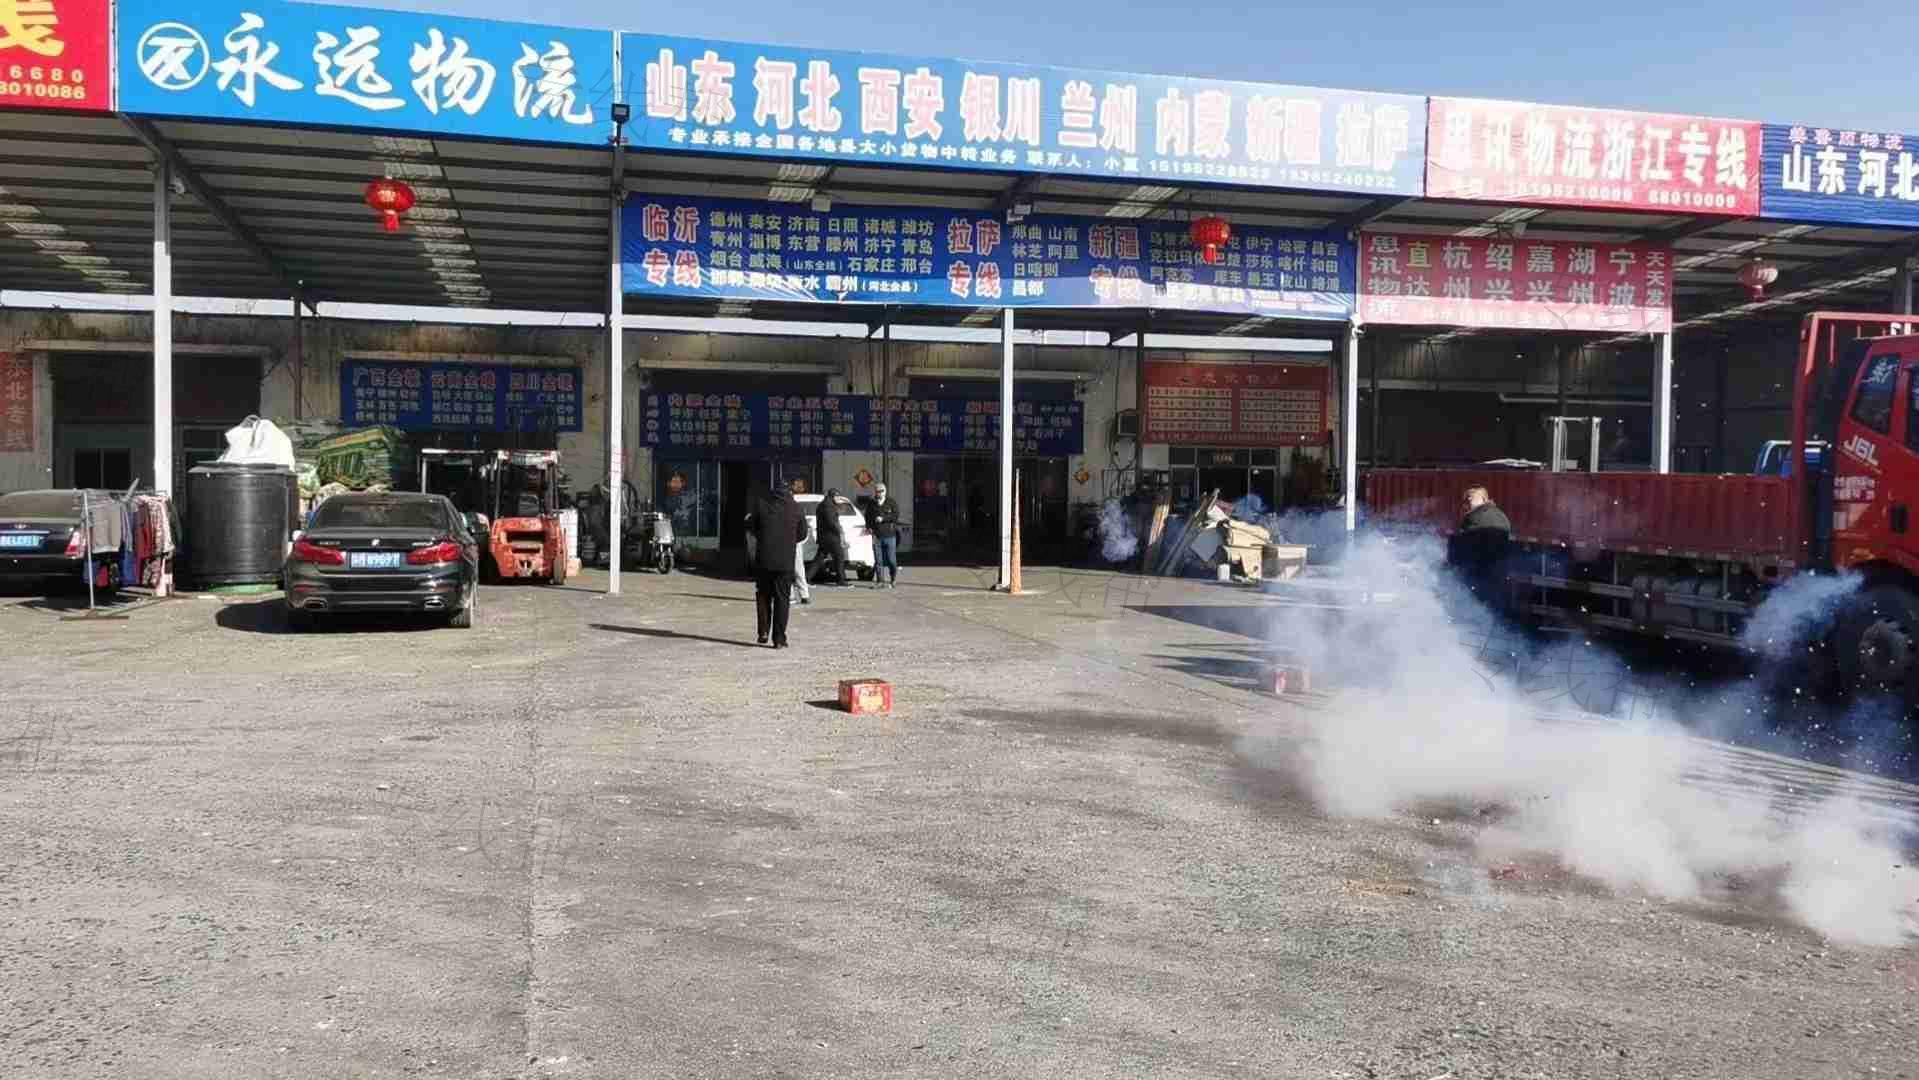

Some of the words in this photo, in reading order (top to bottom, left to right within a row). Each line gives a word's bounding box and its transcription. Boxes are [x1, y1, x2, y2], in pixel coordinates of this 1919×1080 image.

[211, 11, 593, 126] 永远物流
[645, 47, 735, 127] 山东
[753, 56, 842, 132] 河北
[858, 66, 944, 141] 西安
[960, 71, 1041, 147] 银川
[1057, 80, 1137, 154] 兰州
[1156, 87, 1232, 160] 内蒙
[1246, 94, 1322, 166] 新疆
[1782, 144, 1847, 195] 山东
[1857, 149, 1919, 201] 河北
[642, 203, 700, 243] 临沂
[787, 215, 820, 232] 济南
[948, 217, 1001, 256] 拉萨
[1012, 223, 1041, 241] 那曲
[1048, 225, 1079, 242] 山南
[1088, 223, 1140, 260] 新疆
[709, 249, 742, 268] 烟台
[847, 256, 896, 273] 石家庄
[901, 257, 933, 274] 邢台
[787, 235, 820, 252] 东营
[864, 238, 896, 253] 济宁
[901, 239, 934, 256] 青岛
[1012, 243, 1042, 259] 林芝
[1048, 244, 1080, 260] 阿里
[1246, 236, 1273, 252] 伊宁
[1279, 239, 1307, 254] 哈密
[1279, 255, 1306, 272] 喀什
[1311, 257, 1338, 273] 和田
[642, 248, 702, 289] 专线
[948, 260, 1002, 299] 专线
[1013, 261, 1058, 277] 日喀则
[1405, 241, 1432, 295] 直达
[1442, 241, 1472, 299] 杭州
[1484, 242, 1514, 302] 绍兴
[1526, 244, 1555, 305] 嘉兴
[1567, 246, 1596, 305] 湖州
[1608, 248, 1637, 313] 宁波
